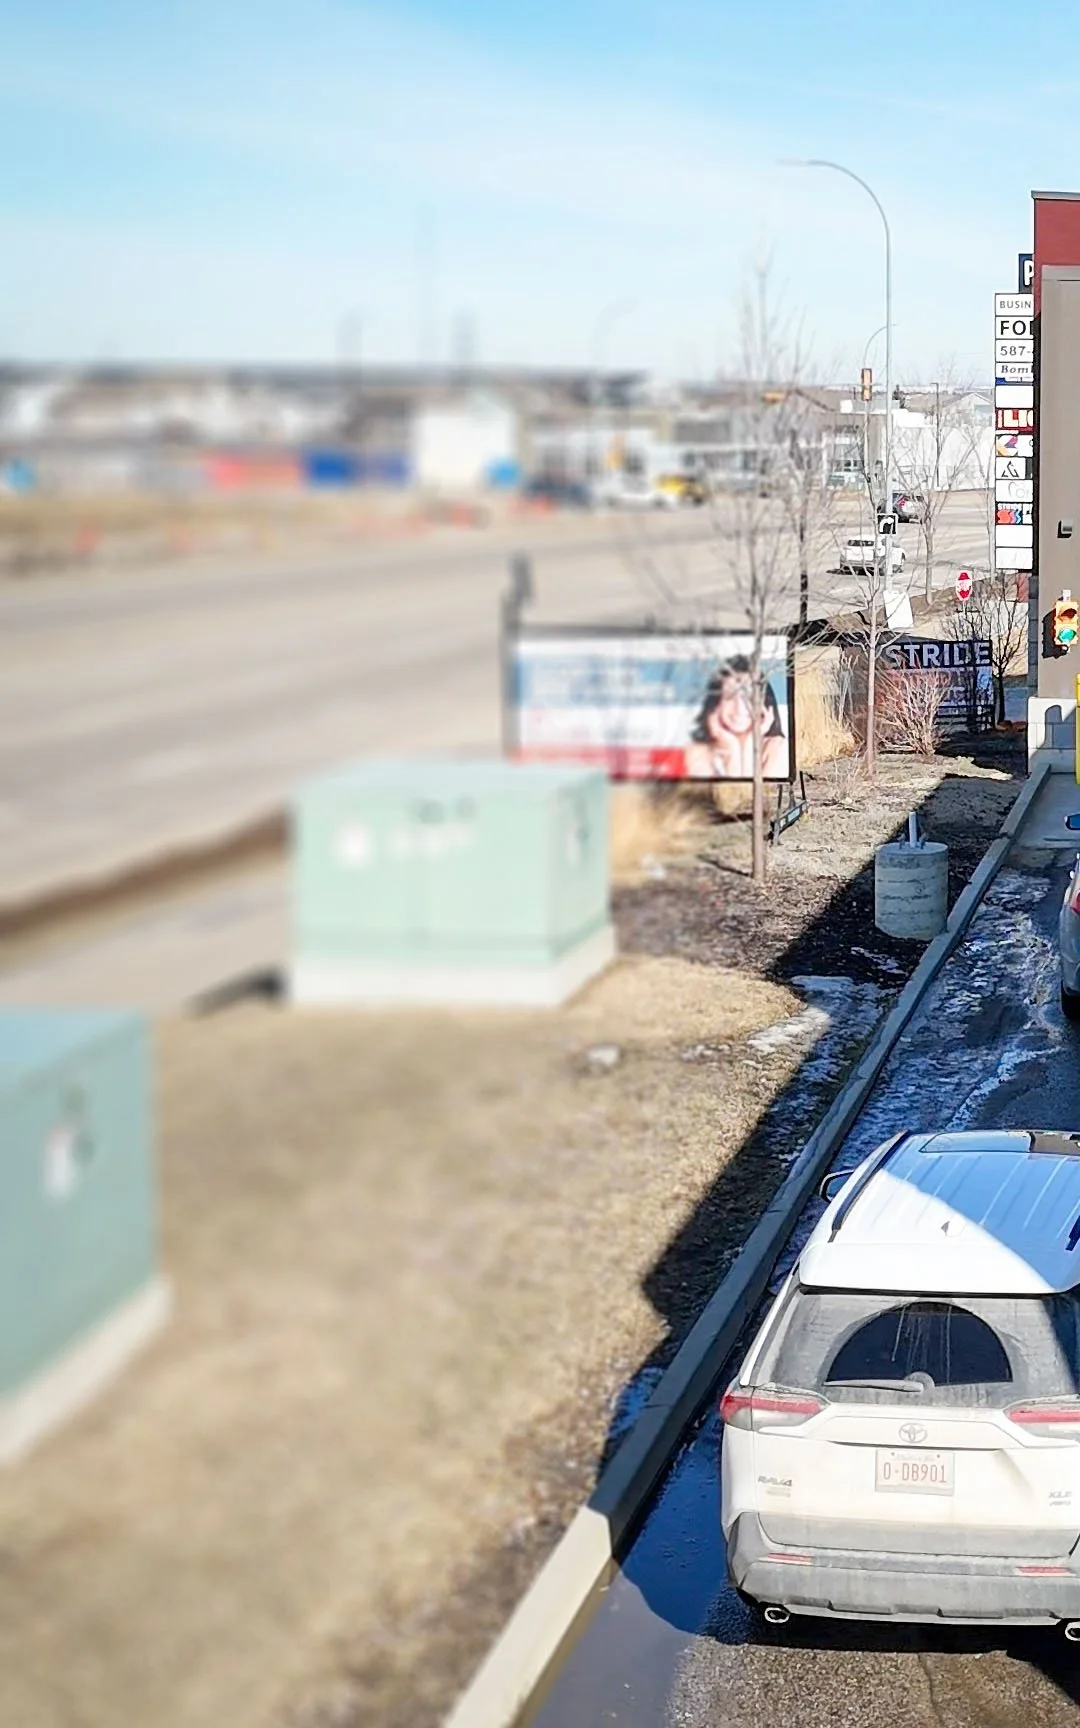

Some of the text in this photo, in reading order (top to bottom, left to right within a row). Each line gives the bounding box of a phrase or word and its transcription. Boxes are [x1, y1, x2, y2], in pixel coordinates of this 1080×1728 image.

[999, 300, 1032, 309] BUSIN
[1000, 345, 1033, 356] 587-
[885, 642, 991, 667] STRIDE
